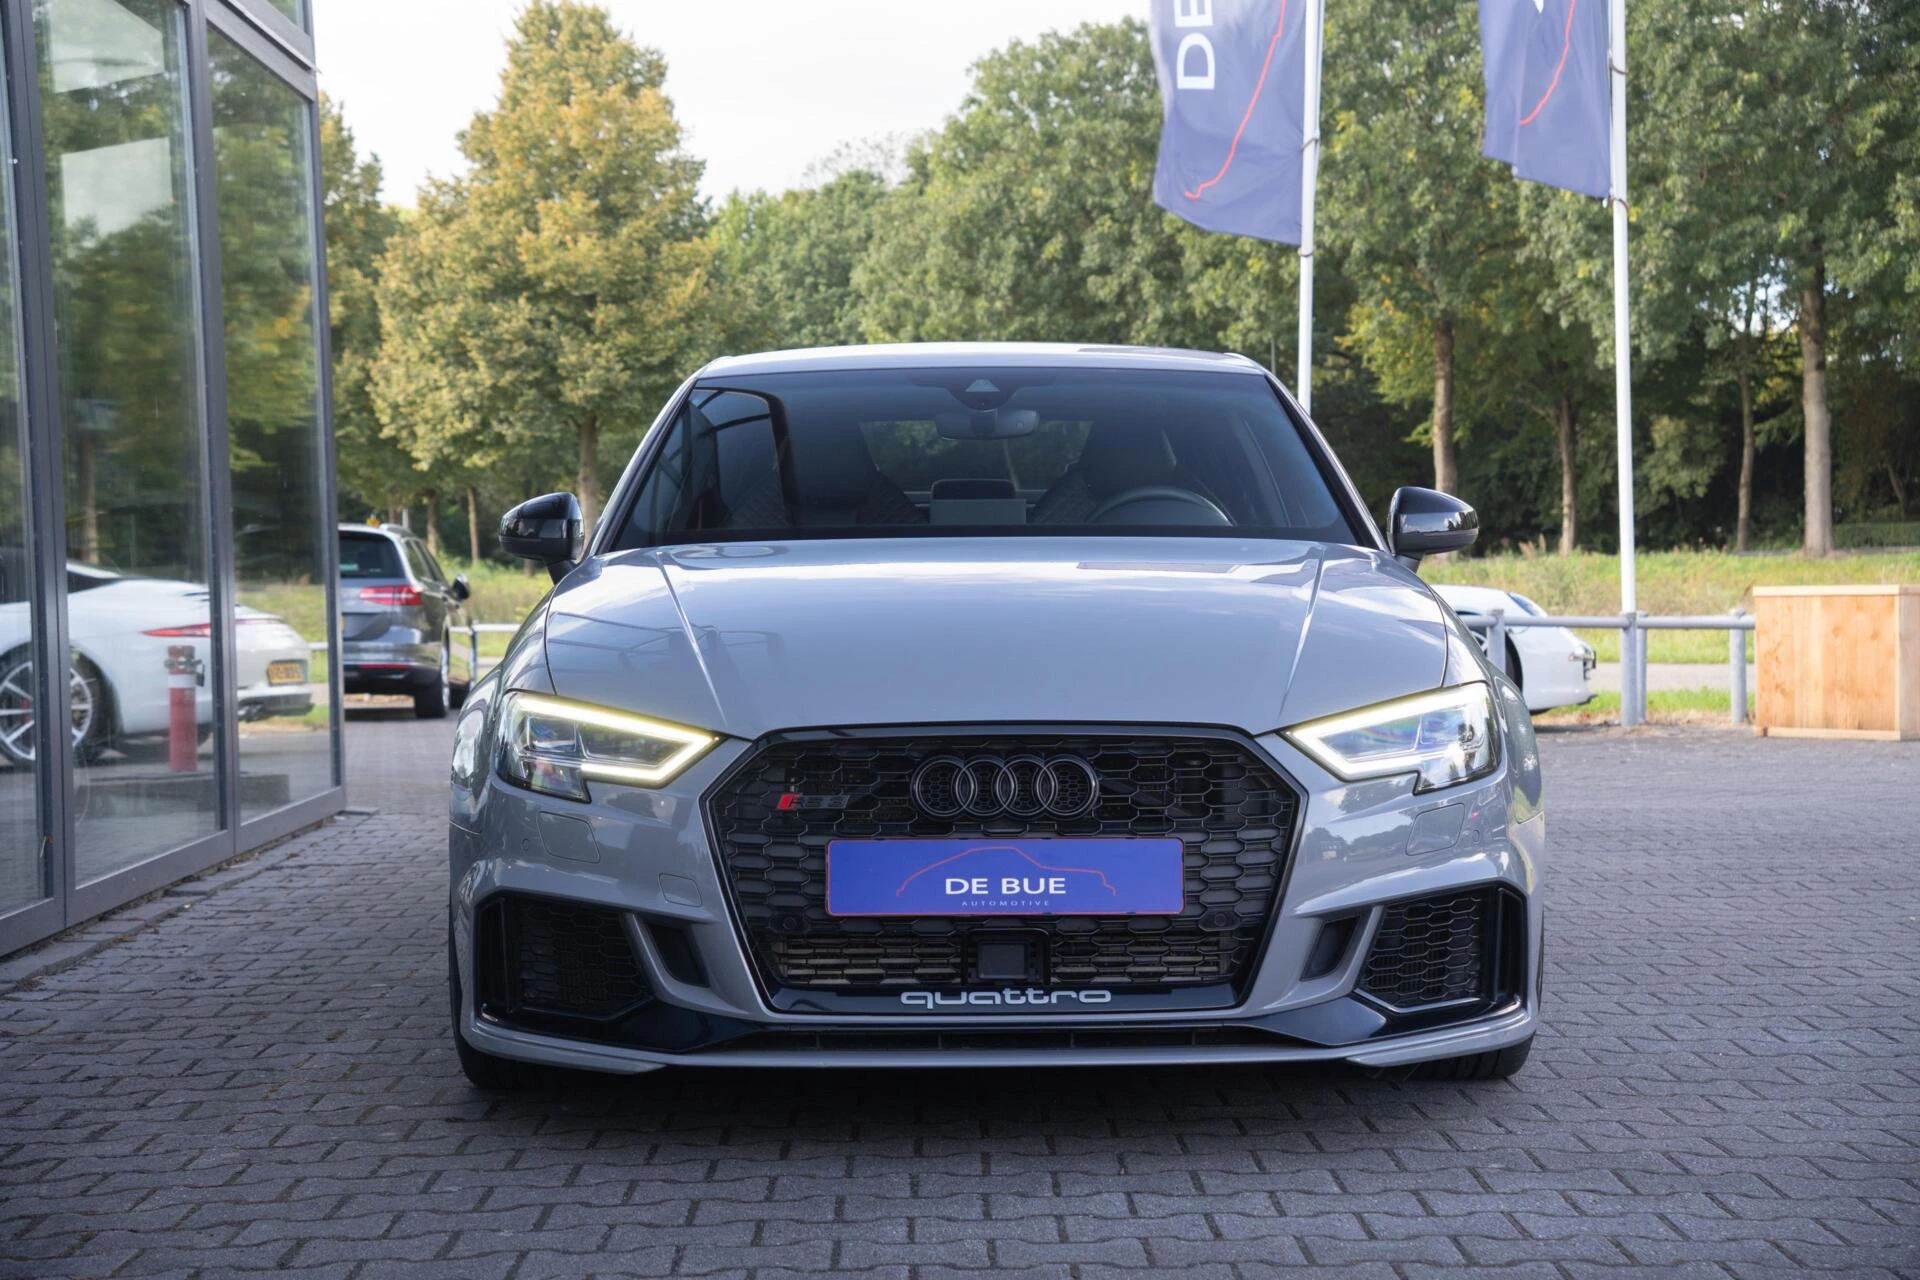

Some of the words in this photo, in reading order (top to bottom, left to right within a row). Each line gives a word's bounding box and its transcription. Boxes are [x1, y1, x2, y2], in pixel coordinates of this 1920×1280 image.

[945, 878, 989, 894] DE
[1001, 878, 1066, 894] BUE
[900, 987, 1112, 1010] quattro
